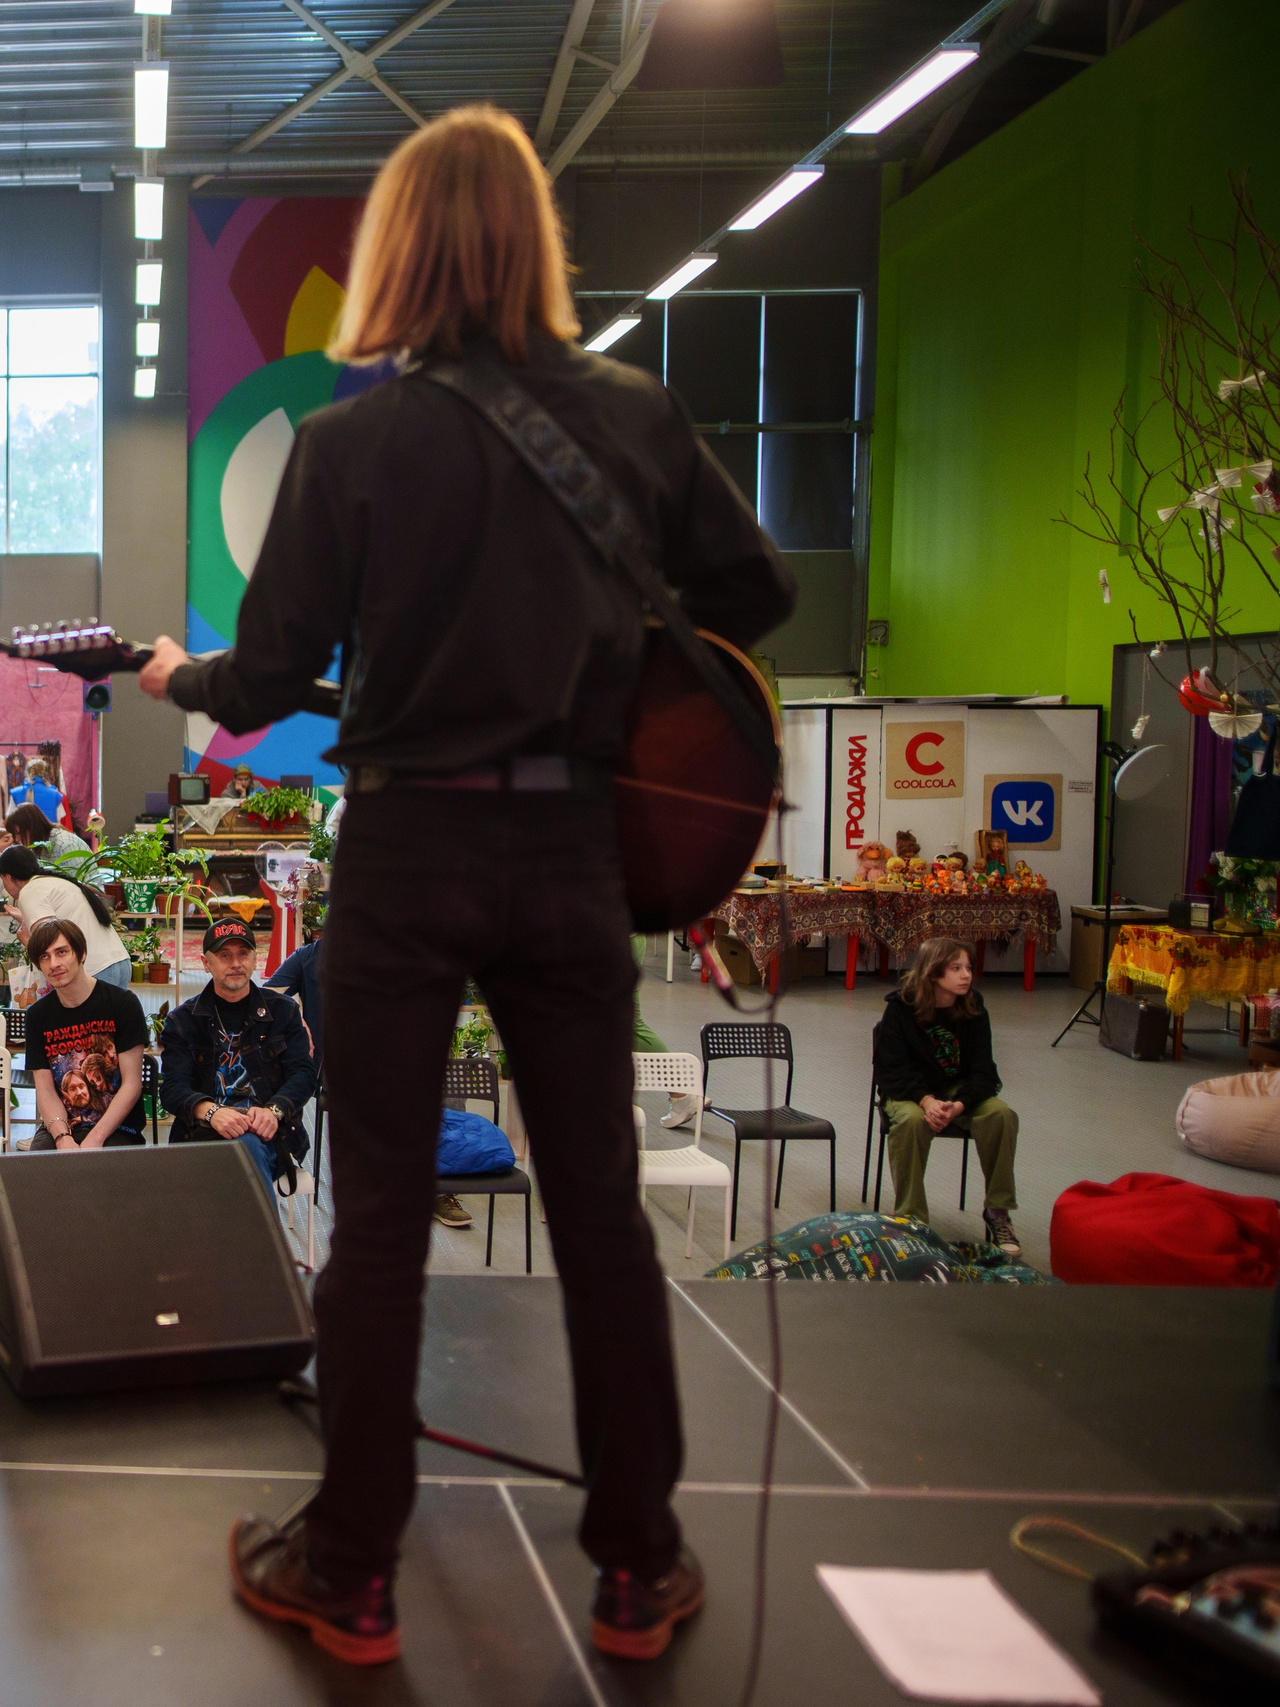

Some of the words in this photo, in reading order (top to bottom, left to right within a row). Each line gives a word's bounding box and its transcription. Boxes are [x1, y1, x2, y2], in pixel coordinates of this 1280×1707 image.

[846, 735, 867, 849] ПРОДАЖИ
[893, 779, 956, 789] COOLCOLA
[1001, 800, 1044, 826] VK
